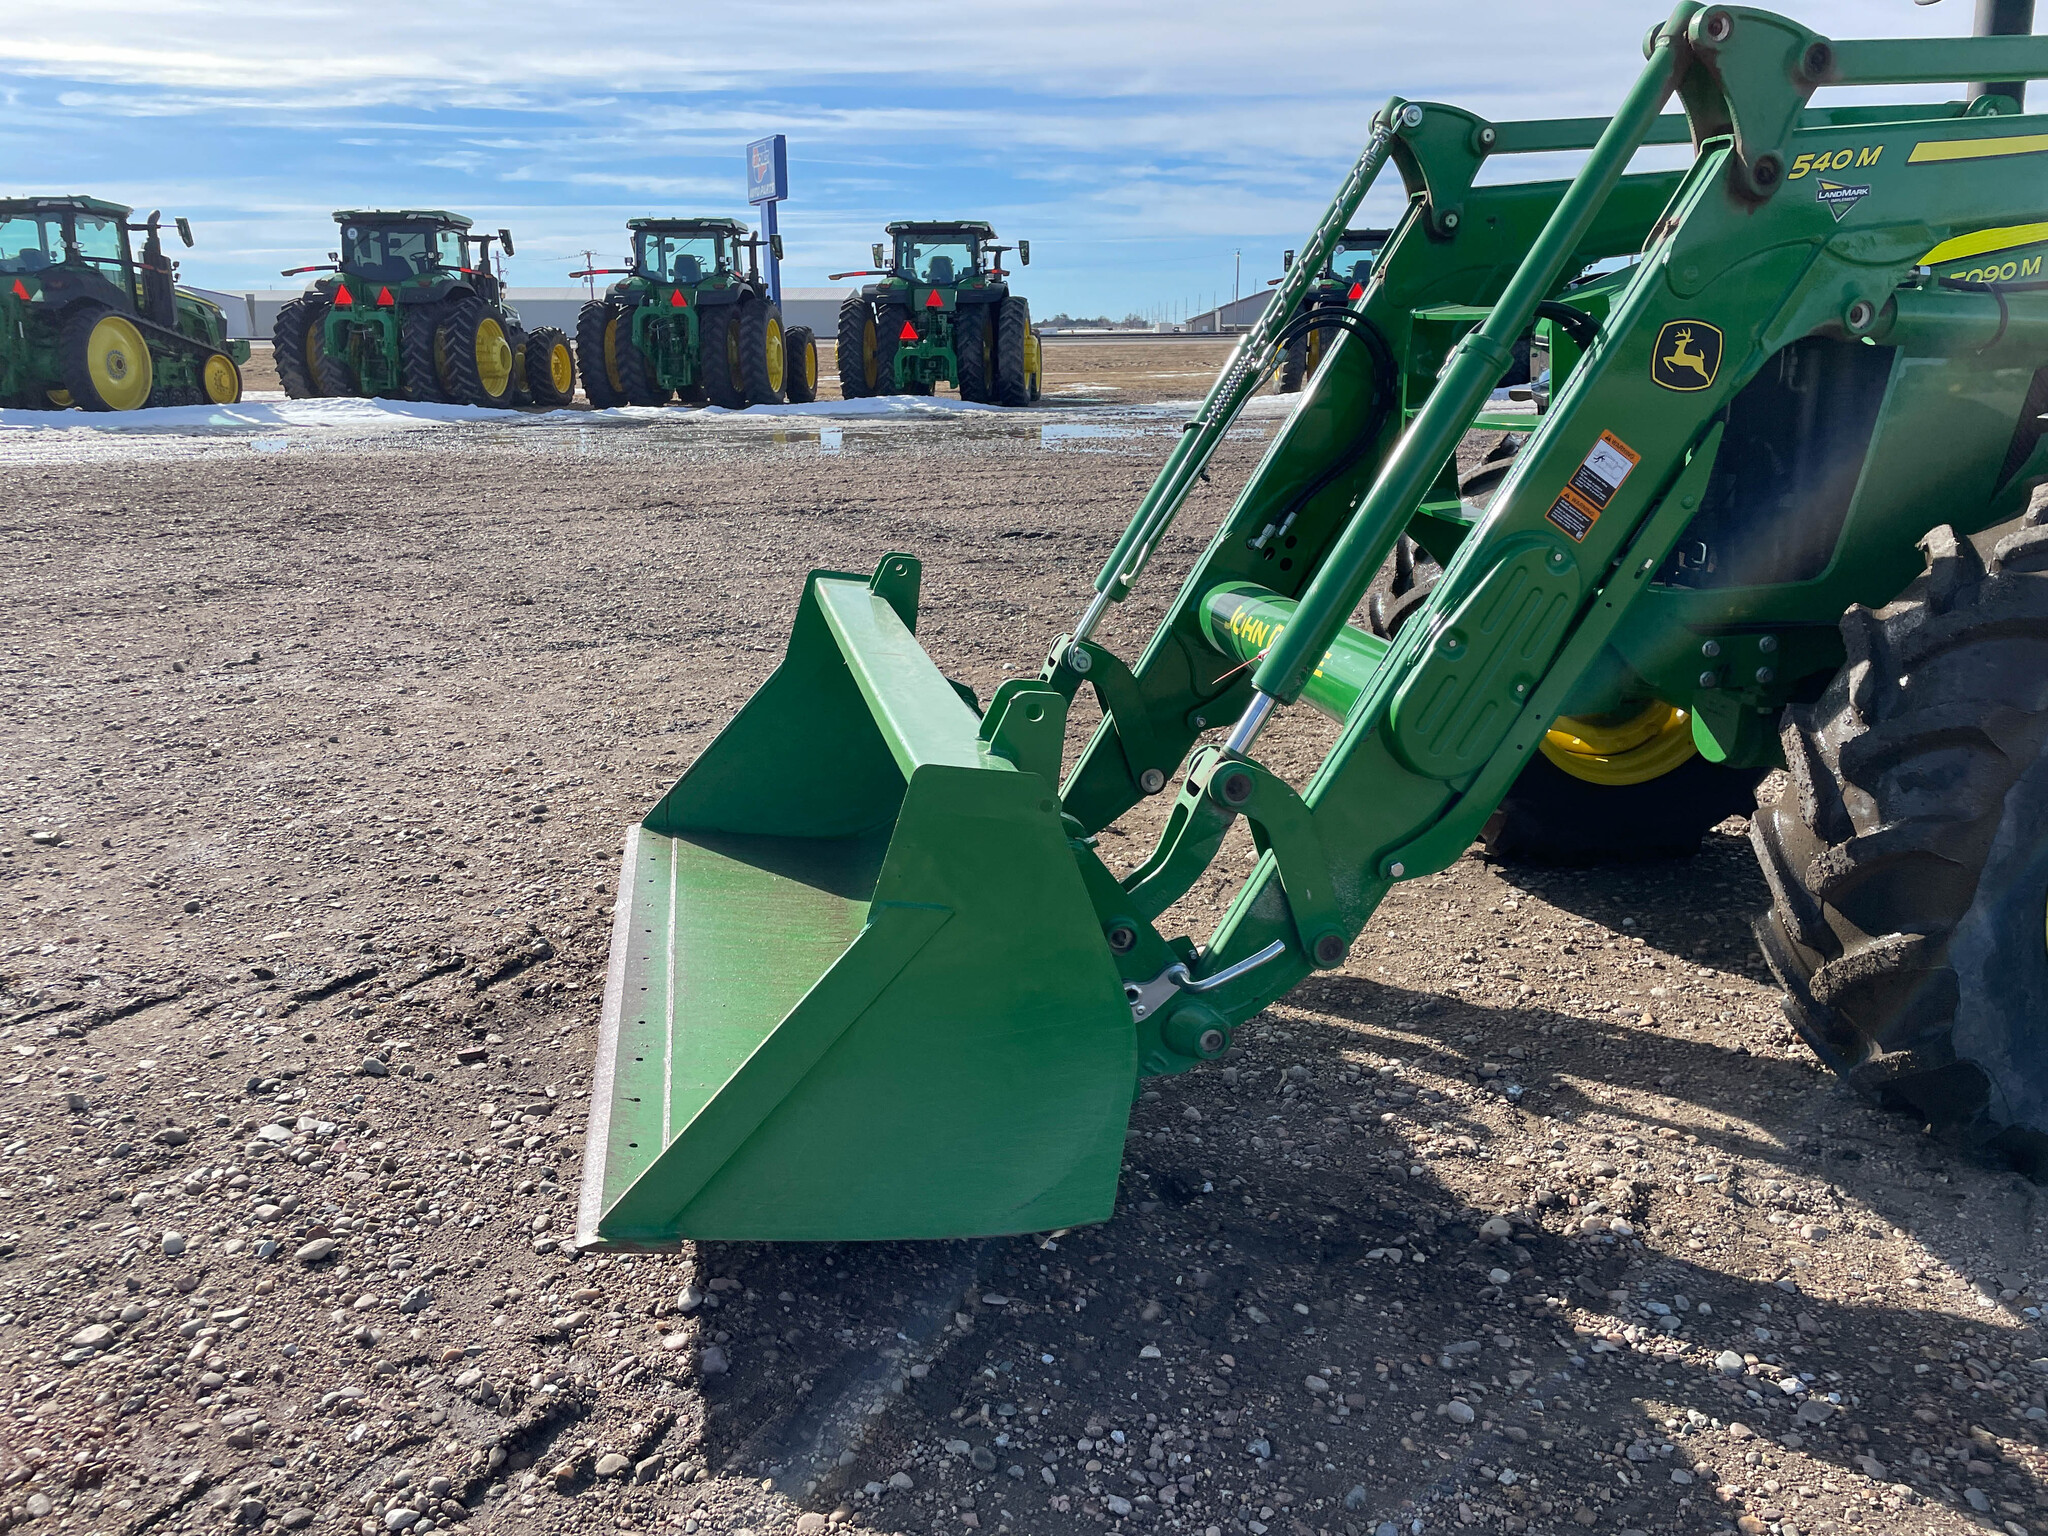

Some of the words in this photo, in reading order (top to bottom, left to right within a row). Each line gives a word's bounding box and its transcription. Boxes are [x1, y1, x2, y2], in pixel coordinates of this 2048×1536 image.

[1788, 149, 1854, 180] 540
[1855, 145, 1884, 168] M
[1950, 261, 2018, 283] 090
[2020, 256, 2042, 277] M
[1611, 439, 1636, 460] WARNING
[1571, 496, 1595, 517] WARNING
[1224, 604, 1271, 648] JOHN
